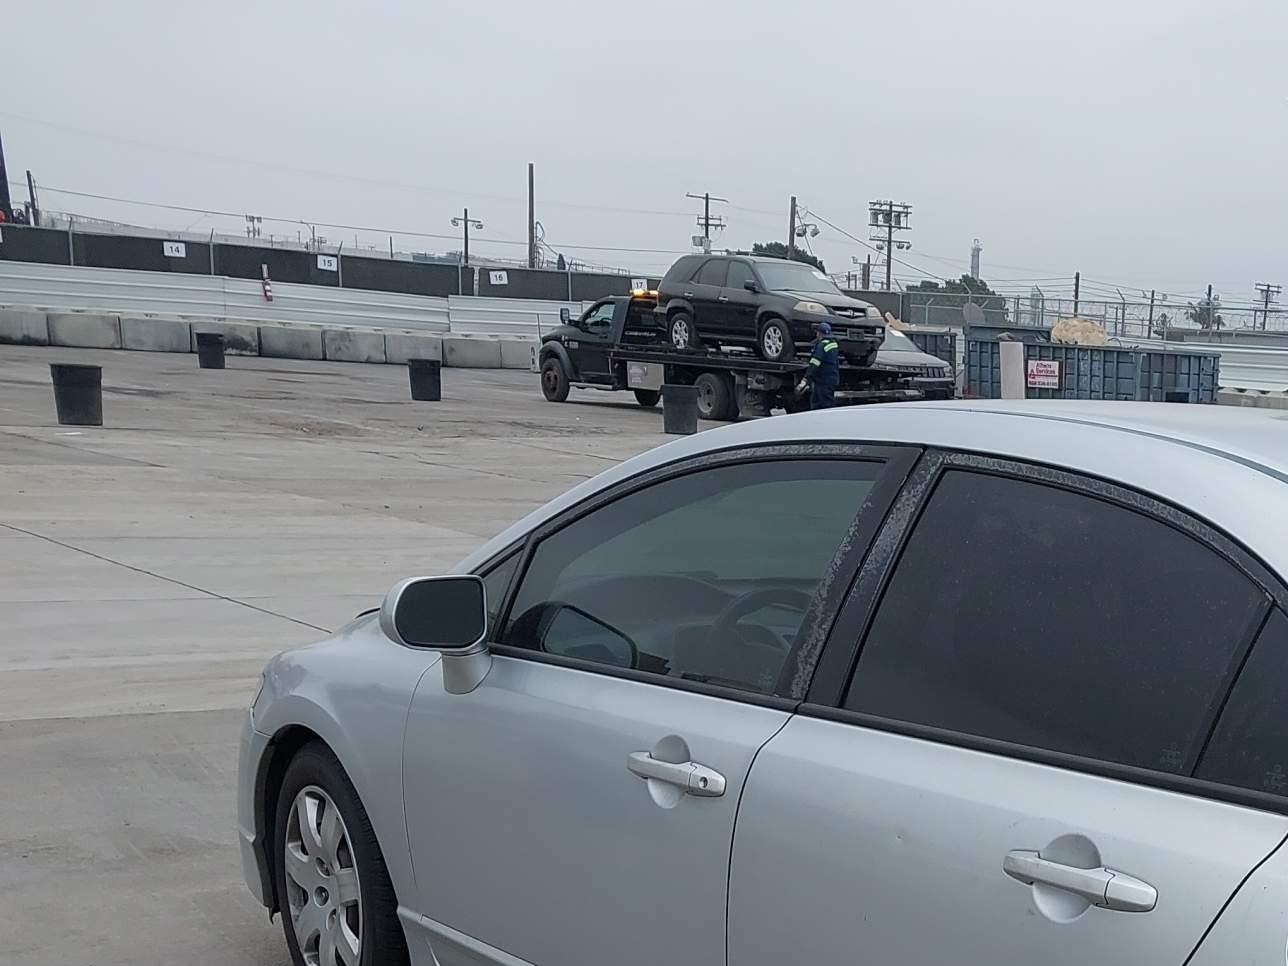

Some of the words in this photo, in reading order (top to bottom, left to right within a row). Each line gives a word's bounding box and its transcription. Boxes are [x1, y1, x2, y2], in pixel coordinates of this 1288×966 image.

[169, 245, 180, 254] 14
[323, 258, 333, 267] 15
[495, 273, 504, 282] 16
